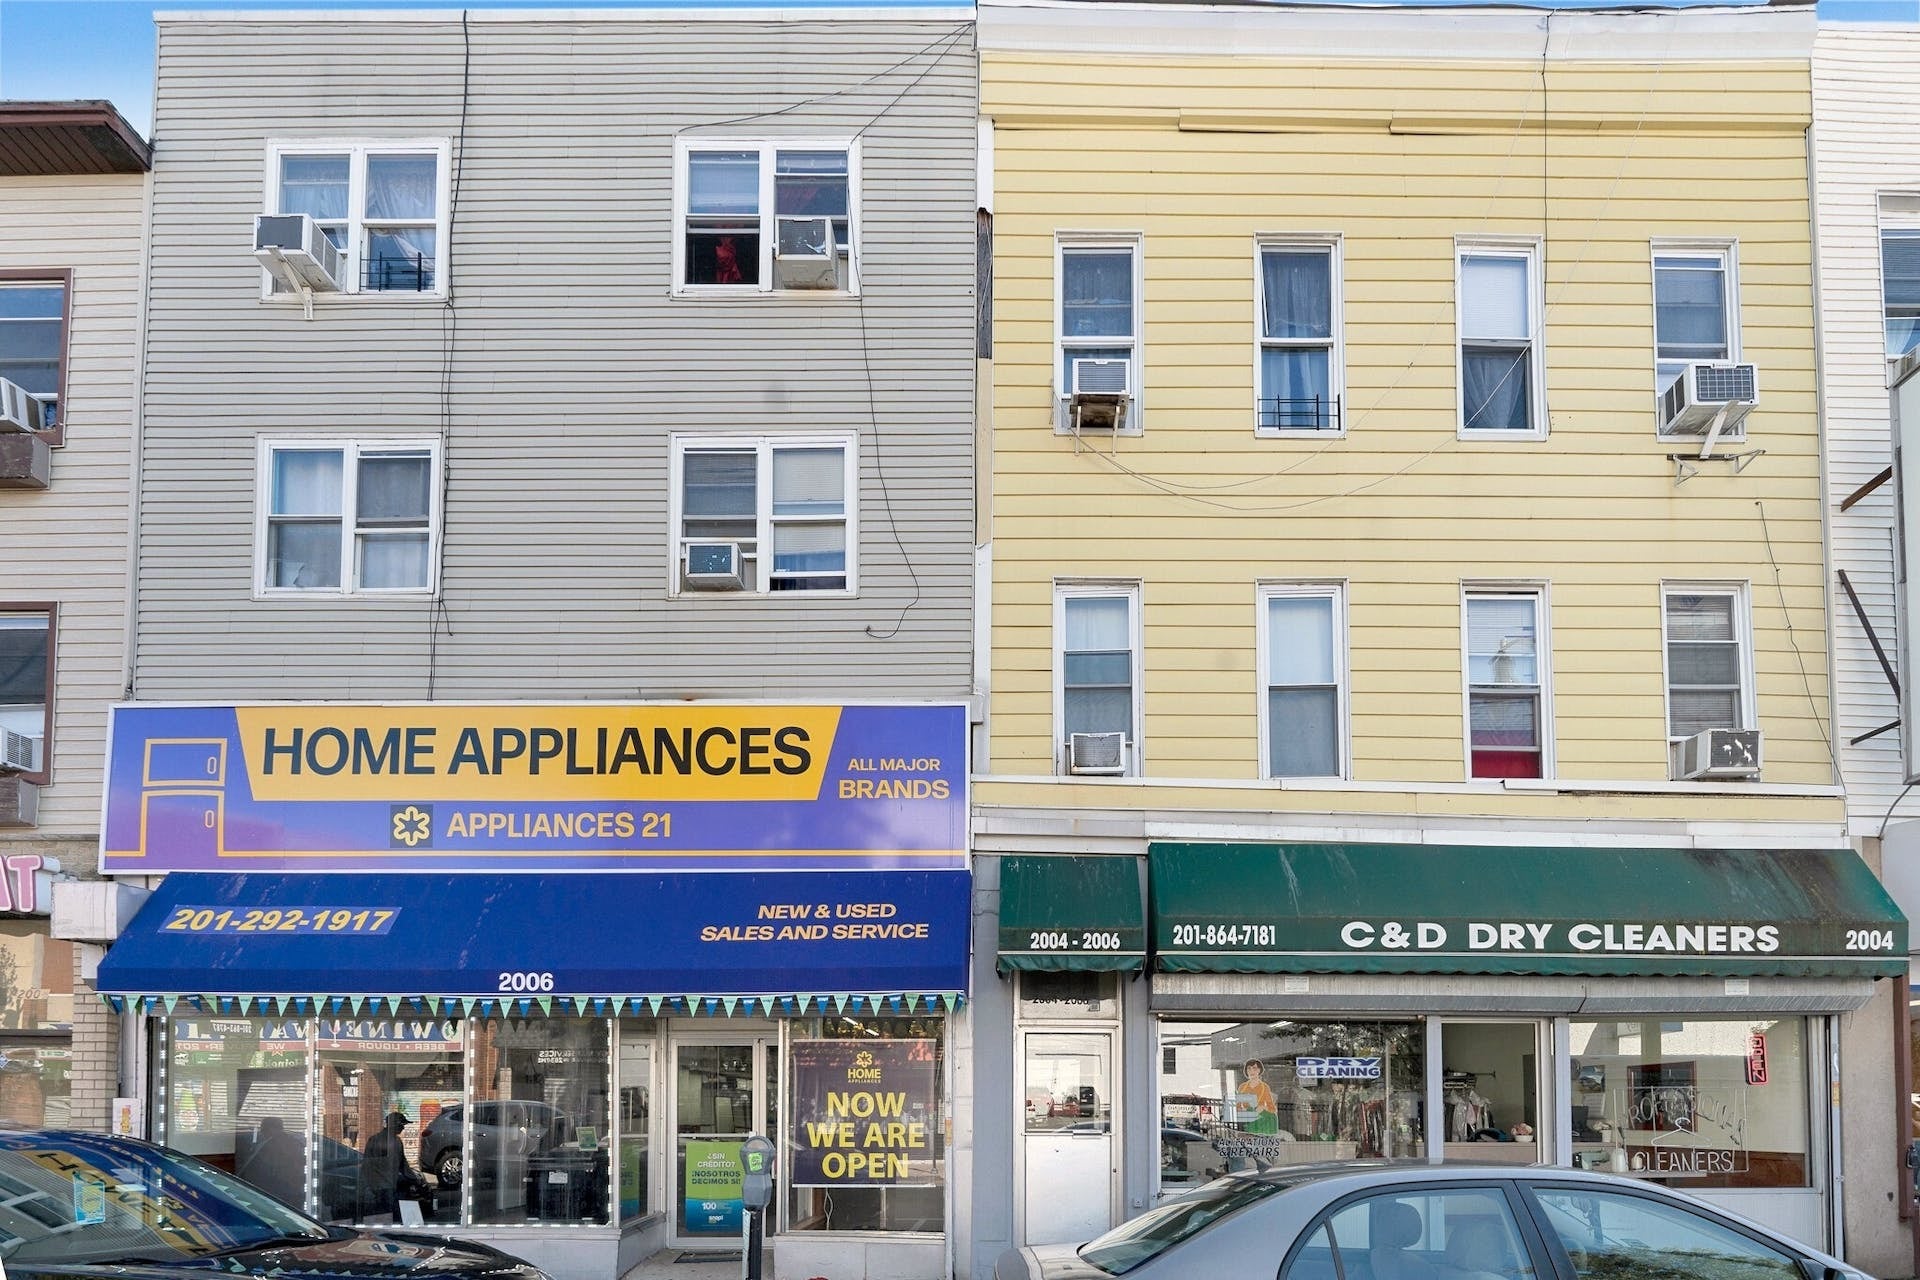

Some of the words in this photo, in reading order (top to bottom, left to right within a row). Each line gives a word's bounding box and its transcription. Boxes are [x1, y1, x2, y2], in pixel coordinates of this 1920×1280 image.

[263, 727, 437, 775] HOME
[447, 726, 812, 775] APPLIANCES
[847, 758, 875, 771] ALL
[880, 758, 940, 771] MAJOR
[838, 779, 950, 800] BRANDS
[446, 812, 635, 838] APPLIANCES
[642, 812, 671, 837] 21
[166, 909, 393, 931] 201-292-1917
[757, 905, 811, 919] NEW
[814, 904, 831, 919] &
[835, 904, 897, 918] USED
[701, 926, 774, 941] SALES
[777, 925, 829, 940] AND
[832, 924, 929, 939] SERVICE
[1030, 932, 1068, 950] 2004
[1083, 932, 1121, 950] 2006
[1173, 925, 1277, 946] 201-864-7181
[1340, 921, 1448, 950] C&D
[1468, 923, 1553, 951] DRY
[1567, 923, 1780, 953] CLEANERS
[1845, 930, 1894, 951] 2004
[498, 972, 554, 992] 2006
[1297, 1058, 1379, 1066] DRY
[1297, 1067, 1380, 1077] CLEANING
[847, 1068, 881, 1079] HOME
[827, 1092, 906, 1117] NOW
[806, 1122, 855, 1148] WE
[863, 1122, 925, 1148] ARE
[1230, 1147, 1280, 1157] REPAIRS
[1635, 1150, 1734, 1172] CLEANERS
[822, 1152, 909, 1178] OPEN
